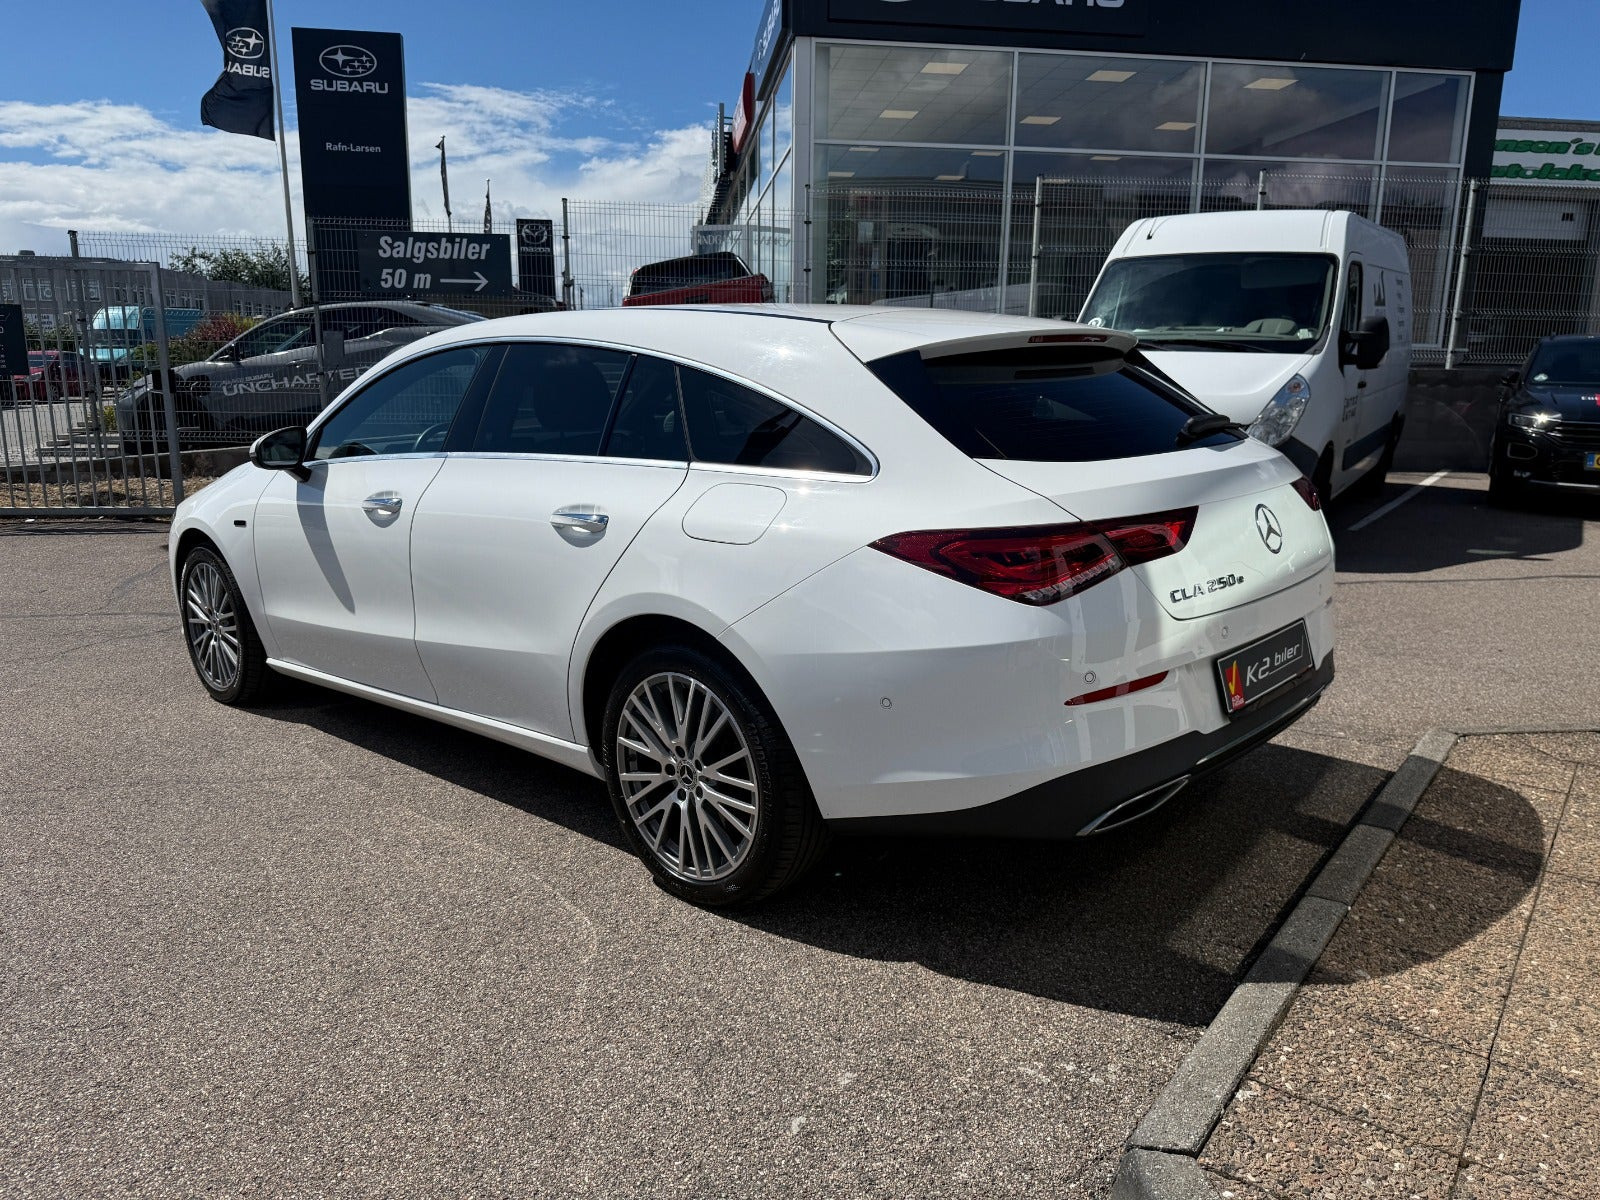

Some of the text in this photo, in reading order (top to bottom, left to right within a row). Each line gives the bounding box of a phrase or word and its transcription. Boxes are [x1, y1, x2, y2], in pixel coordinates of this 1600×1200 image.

[310, 79, 389, 93] SUBARU
[326, 142, 381, 153] Rafn-Larsen
[1490, 163, 1600, 181] utolake
[378, 235, 490, 263] Salgsbiler
[380, 268, 431, 289] 50 m
[1169, 583, 1205, 603] CLA
[1246, 643, 1300, 687] K2 biler
